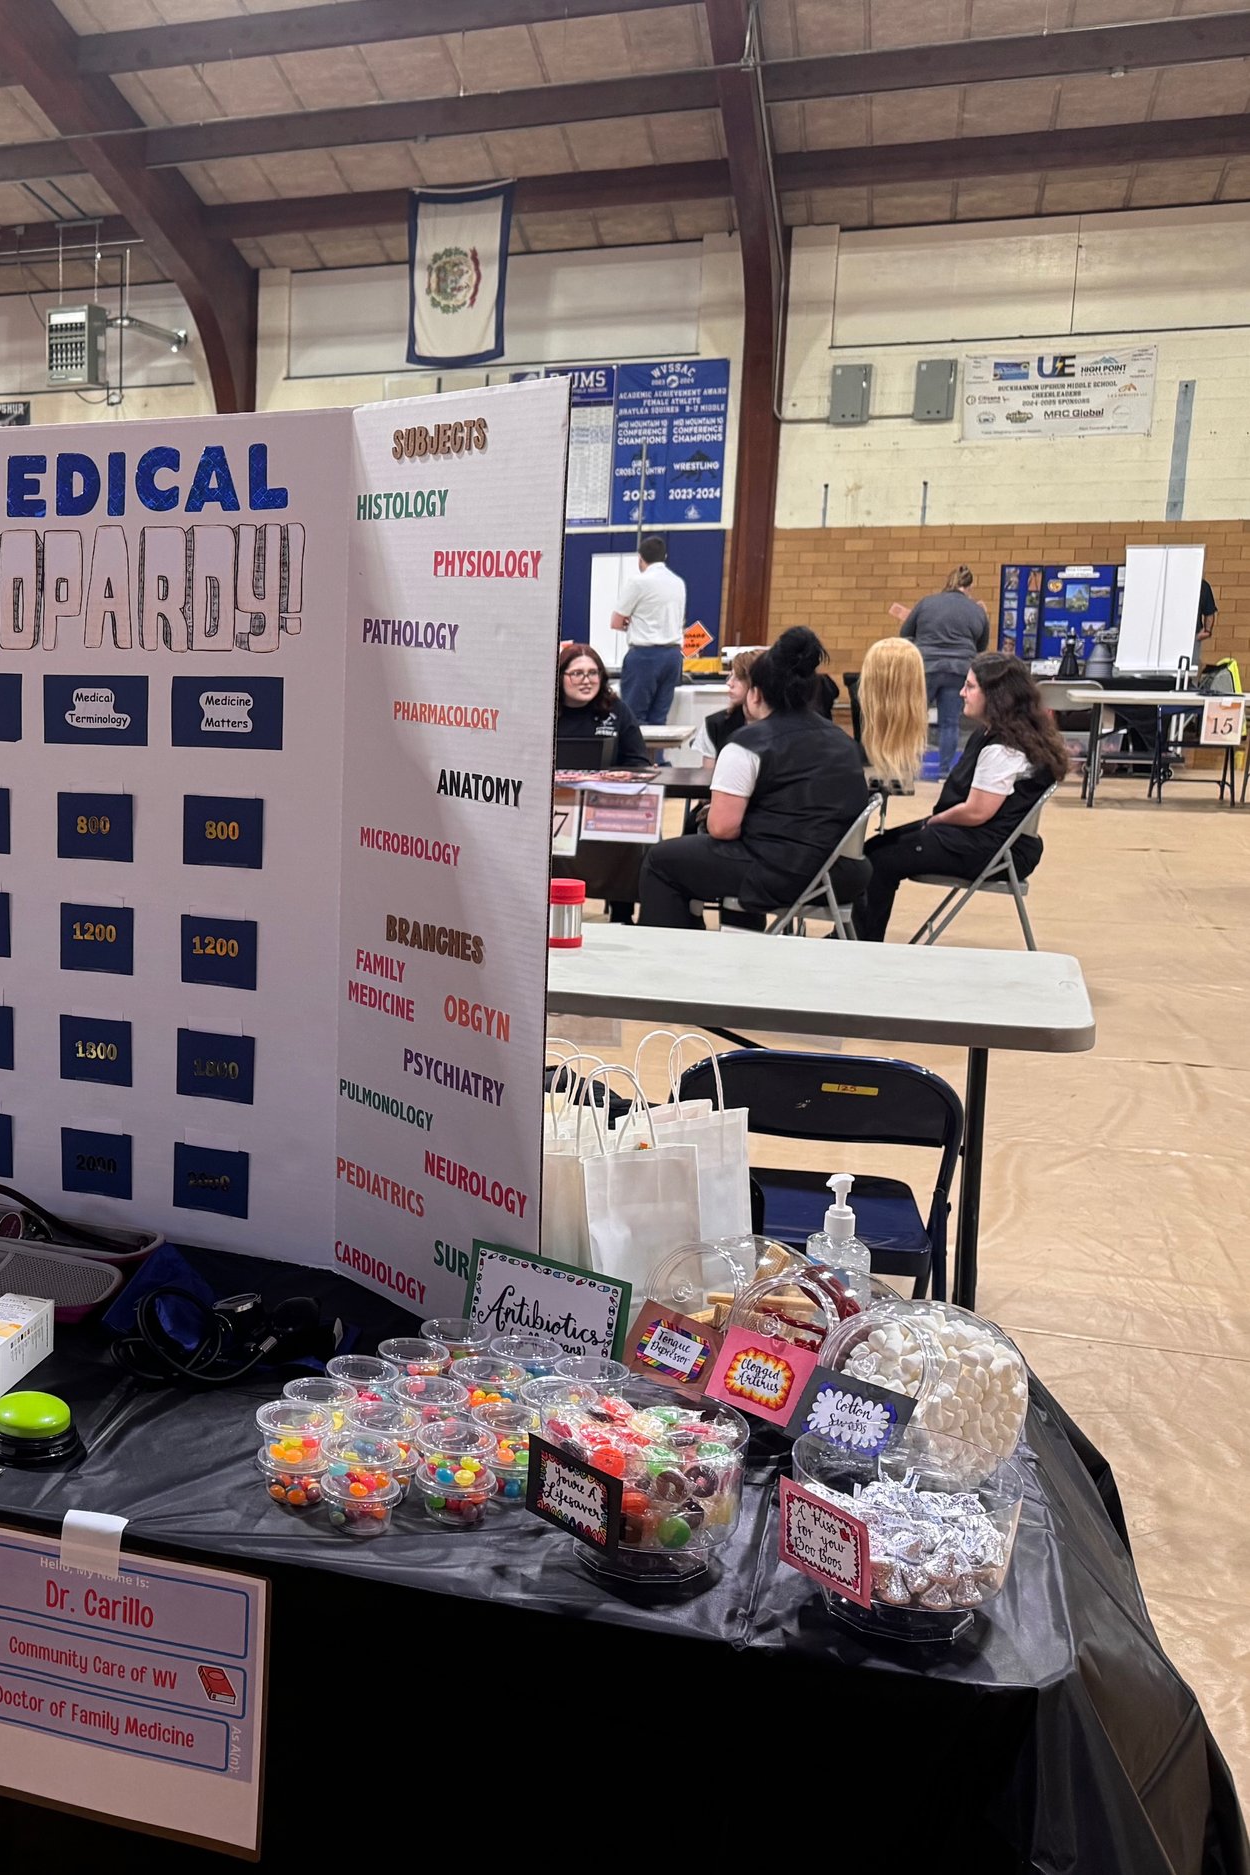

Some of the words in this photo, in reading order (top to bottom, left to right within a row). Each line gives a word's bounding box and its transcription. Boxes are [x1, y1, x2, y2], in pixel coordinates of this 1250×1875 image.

[651, 363, 696, 378] WVSSAC
[619, 391, 652, 399] ACADEMIC
[654, 389, 701, 397] ACHIEVEMENT
[671, 397, 701, 405] ATHLETE
[1044, 410, 1070, 419] MRC
[1072, 408, 1104, 417] Global
[392, 417, 488, 460] SUBJECTS
[618, 428, 667, 436] CONFERENCE
[673, 426, 723, 434] CONFERENCE
[673, 434, 722, 443] CHAMPIONS
[615, 468, 635, 476] CROSS
[673, 461, 719, 470] WRESTLING
[357, 489, 449, 520] HISTOLOGY
[669, 488, 720, 499] 2023-2024
[433, 550, 542, 579] PHYSIOLOGY
[362, 618, 459, 653] PATHOLOGY
[75, 692, 113, 703] Medical
[205, 696, 251, 707] Medicine
[68, 713, 128, 728] Terminology
[205, 717, 249, 728] Matters
[393, 700, 499, 731] PHARMACOLOGY
[1212, 717, 1234, 735] 15
[436, 768, 523, 807] ANATOMY
[76, 815, 110, 835] 800
[205, 820, 239, 840] 800
[360, 826, 461, 867] MICROBIOLOGY
[72, 922, 117, 943] 1200
[386, 914, 484, 965] BRANCHES
[192, 936, 239, 958] 1200
[356, 949, 406, 983] FAMILY
[349, 980, 415, 1022] MEDICINE
[444, 995, 510, 1042] OBGYN
[75, 1040, 118, 1062] 1800
[403, 1048, 505, 1107] PSYCHIATRY
[339, 1078, 433, 1131] PULMONOLOGY
[336, 1156, 425, 1217] PEDIATRICS
[425, 1150, 528, 1218] NEUROLOGY
[334, 1240, 426, 1304] CARDIOLOGY
[477, 1285, 607, 1346] Antibiotics
[657, 1330, 691, 1354] Tongue
[740, 1358, 780, 1380] Clogged
[836, 1399, 872, 1419] Cotton
[544, 1482, 600, 1520] Lifesaver
[588, 1487, 597, 1502] A
[794, 1505, 806, 1520] A
[811, 1511, 837, 1535] Kiss
[796, 1520, 813, 1539] for
[794, 1536, 815, 1557] Boo
[819, 1547, 842, 1571] Boos
[40, 1556, 73, 1575] Hello,
[135, 1575, 150, 1589] Is:
[45, 1579, 76, 1613] Dr.
[84, 1588, 154, 1629] Carillo
[9, 1636, 88, 1673] Community
[93, 1656, 126, 1678] Care
[131, 1665, 147, 1683] of
[152, 1668, 178, 1690] WV
[50, 1702, 67, 1717] of
[71, 1703, 119, 1735] Family
[124, 1717, 194, 1748] Medicine
[231, 1725, 240, 1744] As
